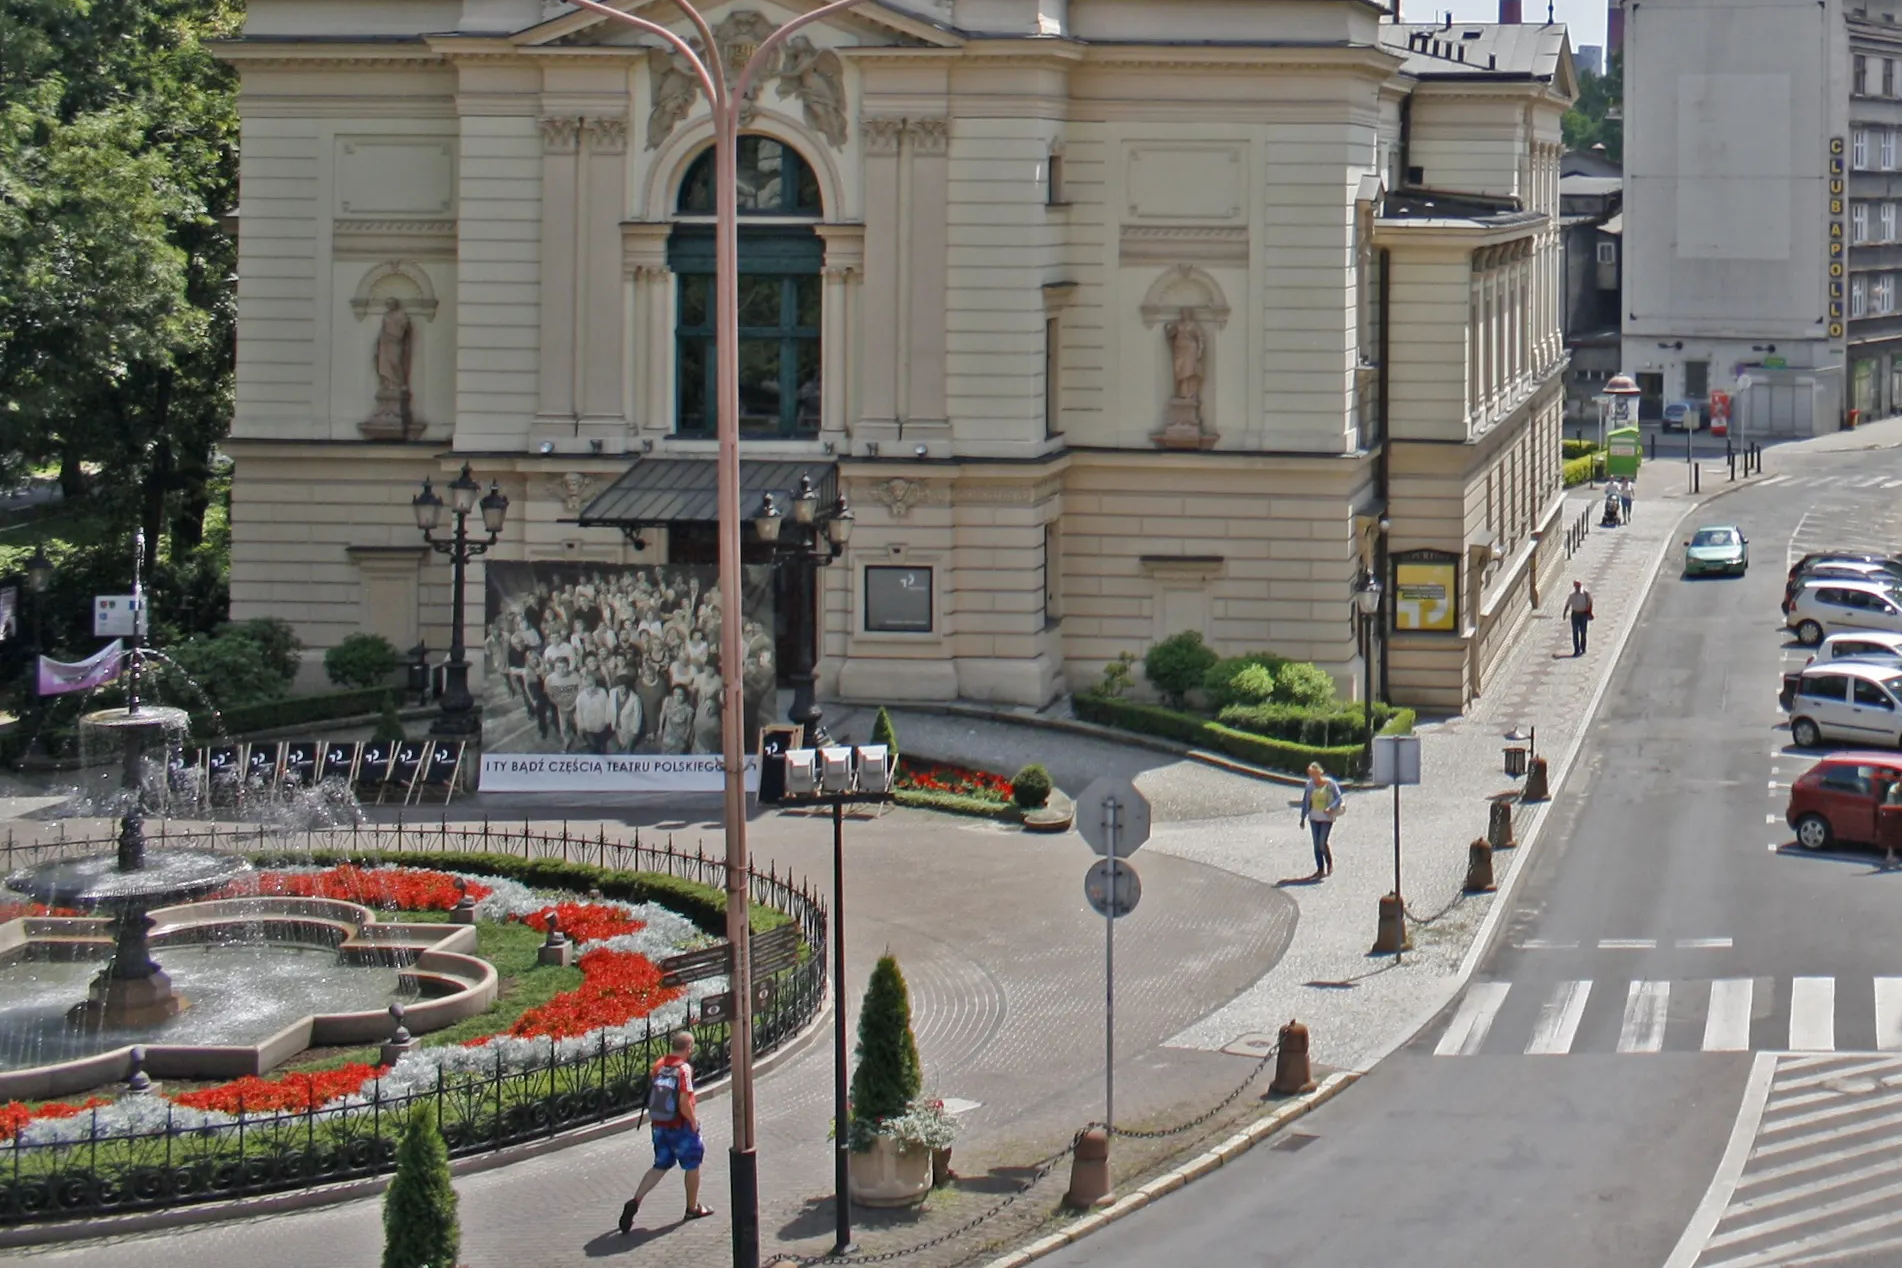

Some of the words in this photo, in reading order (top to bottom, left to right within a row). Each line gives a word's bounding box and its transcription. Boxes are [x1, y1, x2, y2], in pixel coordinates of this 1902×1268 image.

[1830, 139, 1843, 214] CLUB
[1830, 222, 1843, 336] APOLLO
[486, 761, 490, 771] I
[494, 761, 507, 771] TY
[511, 757, 544, 774] BĄDŹ
[548, 758, 602, 774] CZĘŚCIĄ
[607, 761, 650, 772] TEATRU
[654, 761, 725, 772] POLSKIEGO
